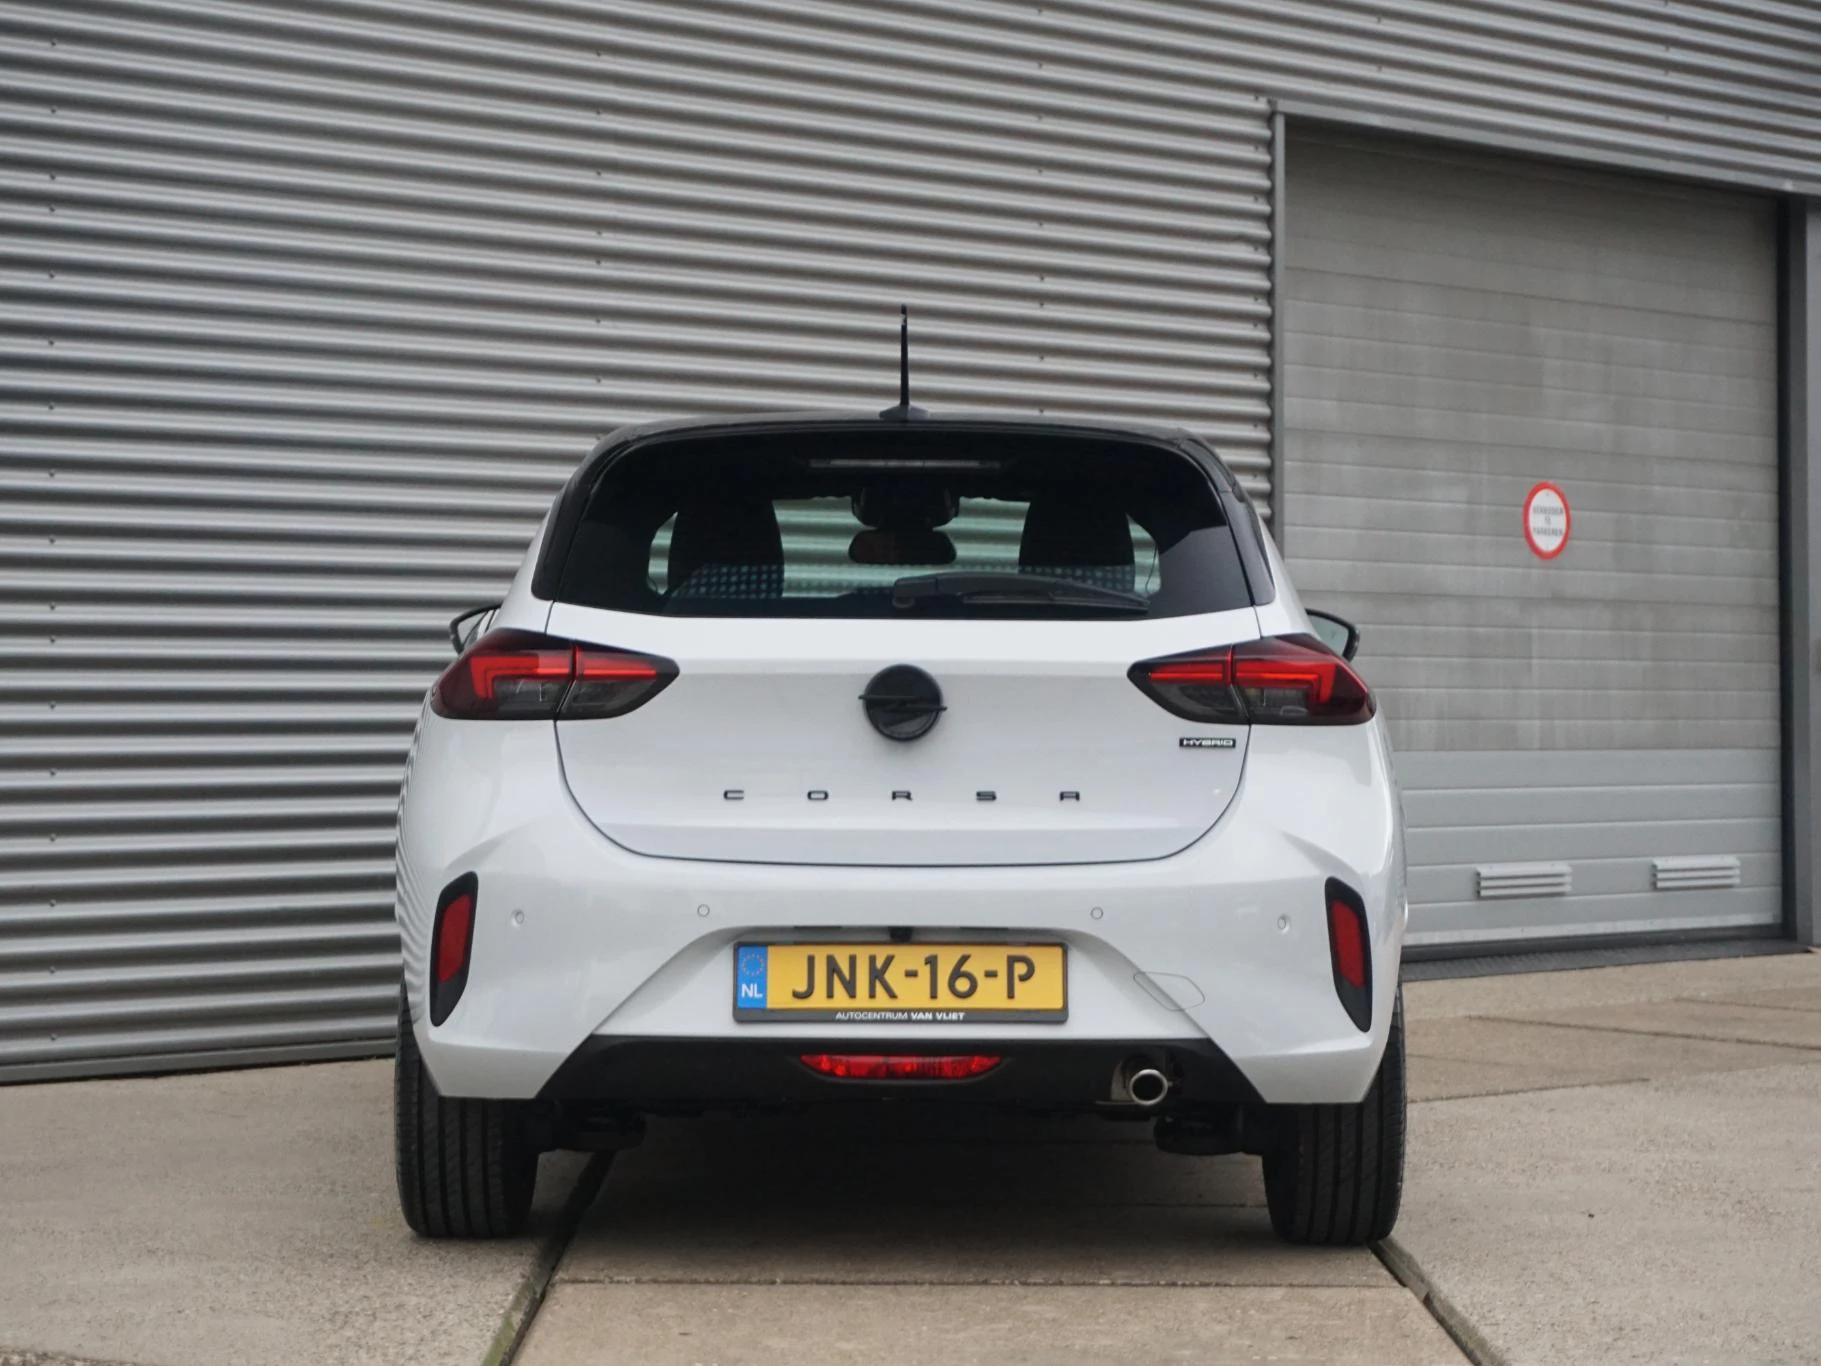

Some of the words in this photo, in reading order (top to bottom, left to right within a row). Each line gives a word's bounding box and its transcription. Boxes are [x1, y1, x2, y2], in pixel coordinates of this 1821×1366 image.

[1182, 738, 1234, 747] HYBRID
[723, 790, 1080, 802] CORSA
[792, 954, 1035, 999] JNK-16-P
[742, 984, 763, 998] NL
[835, 1011, 908, 1020] AUTOCENTRUM
[910, 1011, 933, 1020] VAN
[935, 1011, 965, 1020] VLIET
